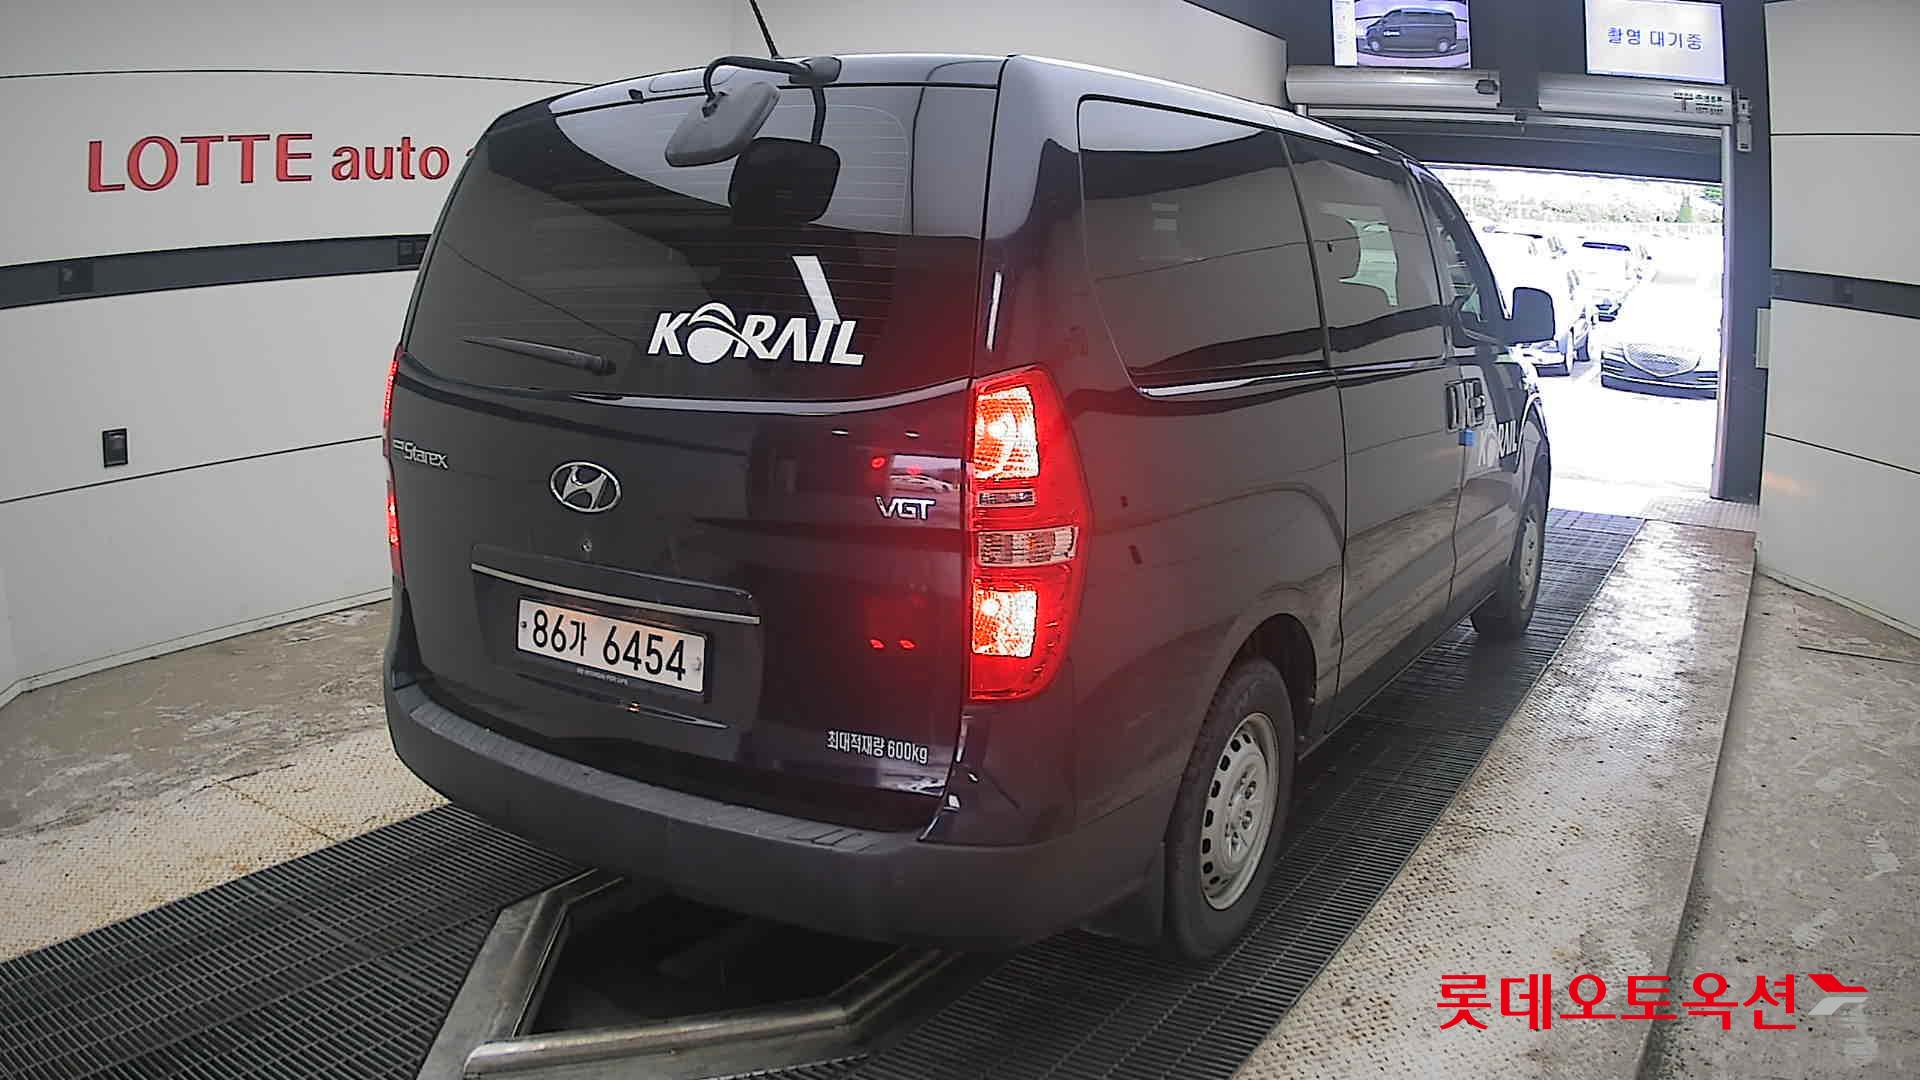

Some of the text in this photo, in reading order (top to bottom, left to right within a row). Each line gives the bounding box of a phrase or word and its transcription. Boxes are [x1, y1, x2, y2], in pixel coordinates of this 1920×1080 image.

[1608, 26, 1702, 51] 촬영 대기중
[87, 133, 451, 193] LOTTE auto
[647, 301, 865, 366] KORAIL
[875, 495, 936, 520] VGT
[532, 609, 687, 682] 86가 6454
[827, 730, 928, 764] 최대적재량 600kg
